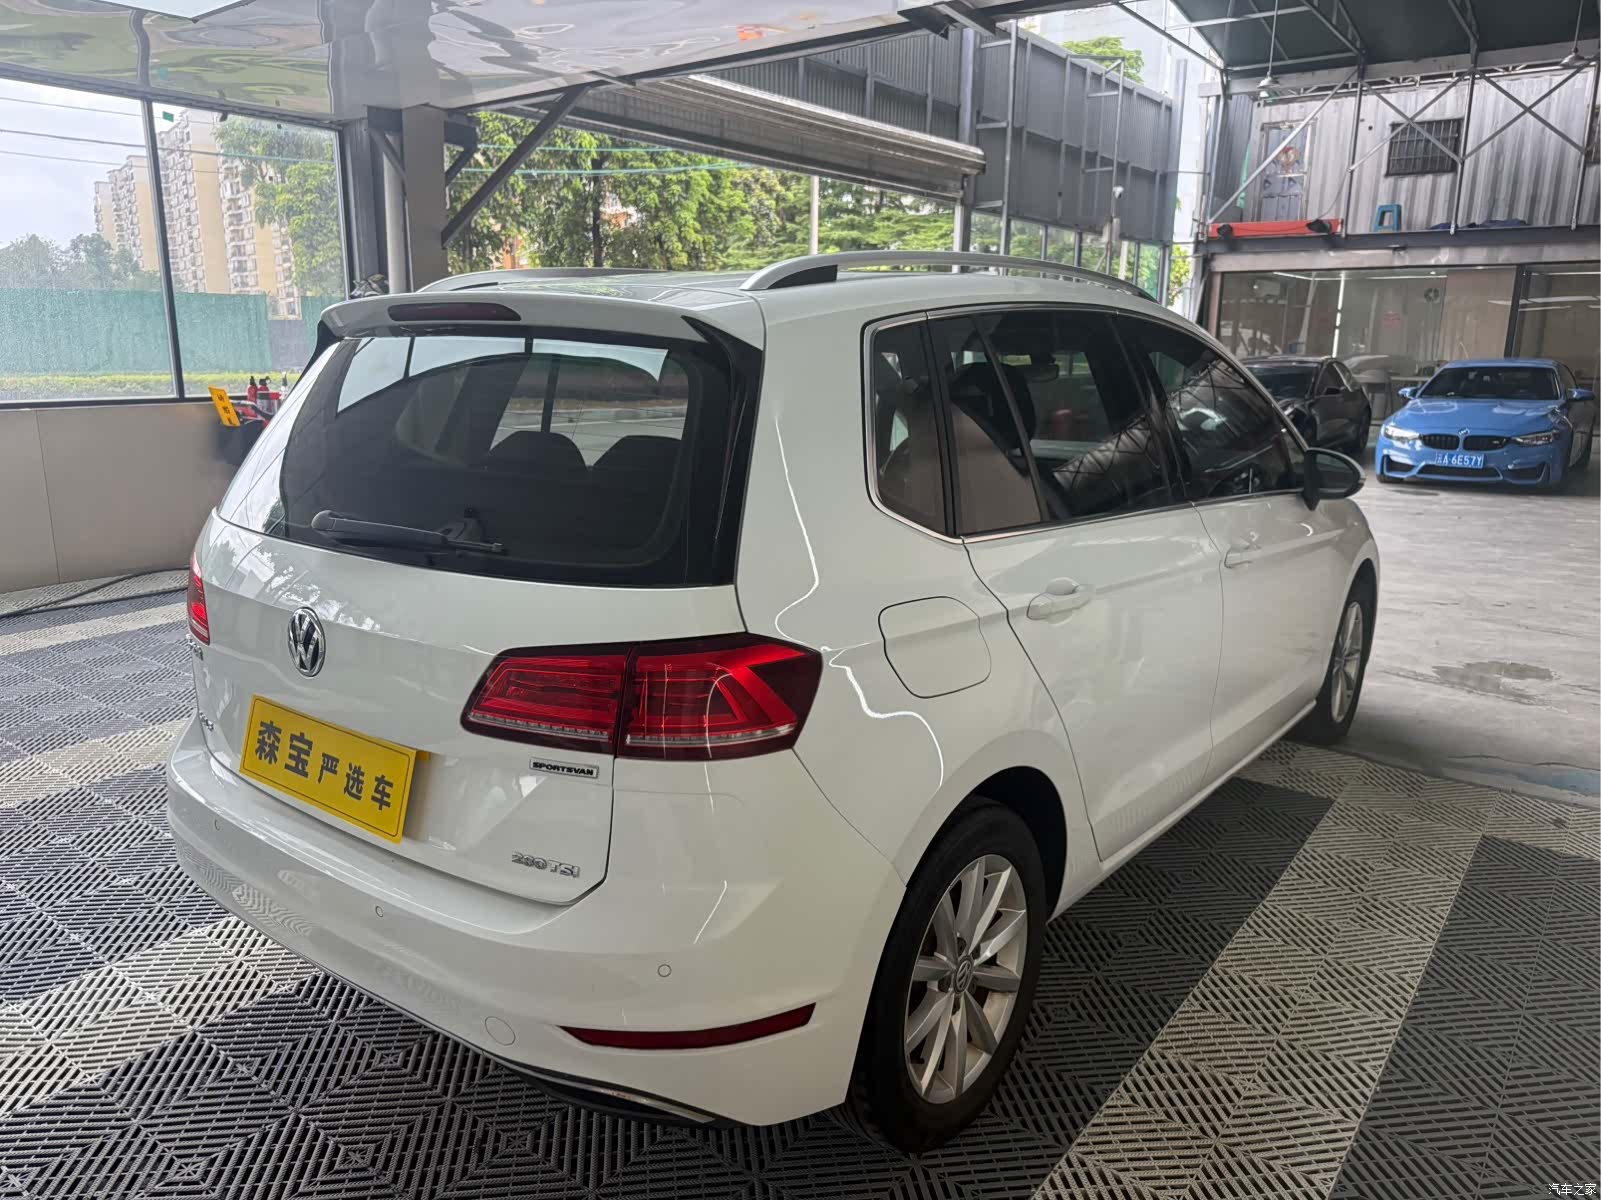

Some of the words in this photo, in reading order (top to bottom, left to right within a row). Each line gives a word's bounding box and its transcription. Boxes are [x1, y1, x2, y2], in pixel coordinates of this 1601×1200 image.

[254, 719, 394, 811] 森宝严选车
[532, 761, 594, 776] SPORTSVAN
